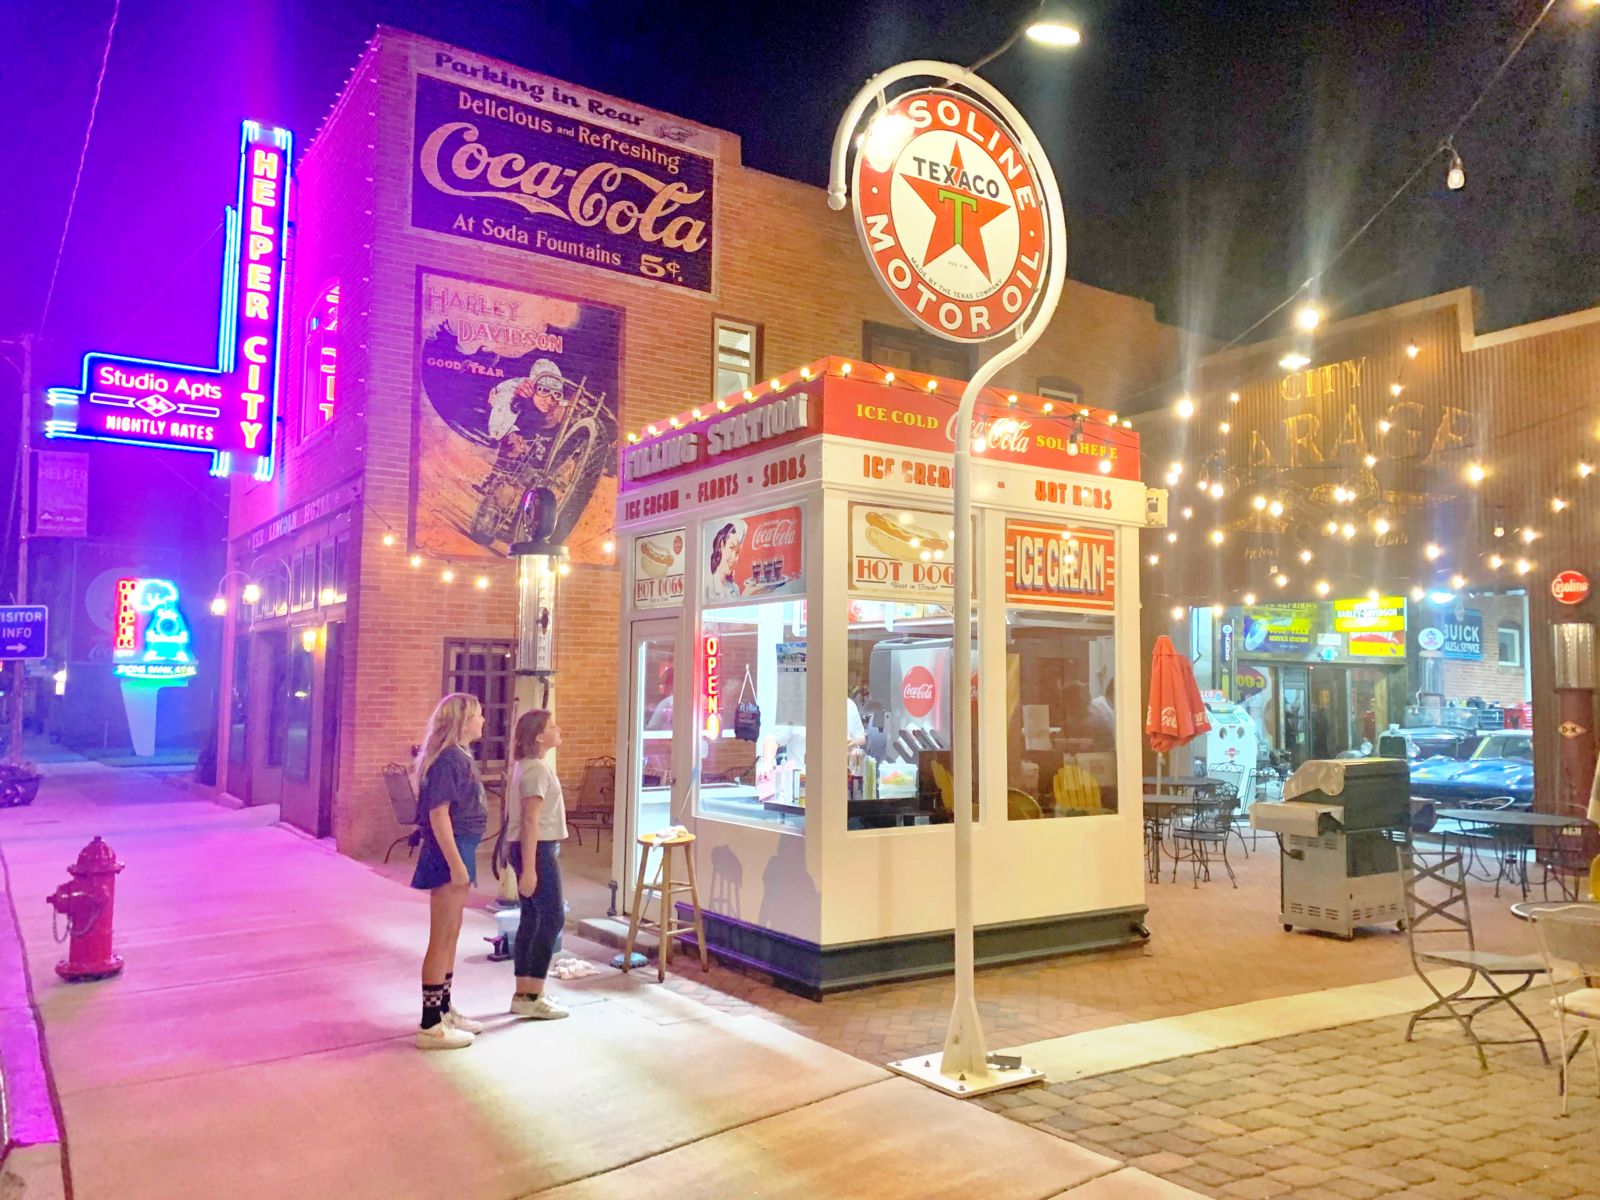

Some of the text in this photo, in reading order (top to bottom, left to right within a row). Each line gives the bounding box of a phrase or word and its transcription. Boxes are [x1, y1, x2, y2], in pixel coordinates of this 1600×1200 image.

[435, 52, 644, 127] Parking in Rear
[458, 91, 681, 174] Delicious and Refreshing
[908, 100, 1037, 212] SOLINE
[913, 156, 1000, 199] TEXACO
[420, 121, 707, 253] Coca-Cola
[453, 213, 475, 234] At
[482, 219, 529, 246] Soda
[536, 231, 621, 266] Fountains
[938, 188, 978, 246] T
[866, 214, 1040, 333] MOTOR OIL
[911, 257, 927, 278] MADE
[939, 284, 951, 296] THE
[953, 291, 974, 299] TEXAS
[975, 278, 1003, 298] COMPANY
[240, 150, 278, 449] HELPER CITY
[425, 286, 520, 321] HARLEY
[457, 318, 563, 354] DAVIDSON
[99, 366, 222, 400] Studio Apts
[1281, 356, 1366, 400] CITY
[106, 415, 214, 441] NIGHTLY RATES
[626, 392, 808, 481] FILLING STATION
[856, 404, 888, 421] ICE
[892, 411, 939, 430] COLD
[1036, 435, 1073, 452] SOL
[1248, 402, 1478, 468] ARAGE
[625, 454, 807, 521] ICE CREAM FLOATS SODAS
[902, 460, 955, 489] CREA
[1035, 479, 1112, 510] HOT DOGS
[857, 559, 955, 585] HOT DOG
[1015, 535, 1105, 593] ICE CREAM
[637, 576, 684, 599] HOT DOGS
[0, 612, 43, 623] ISITOR
[2, 627, 32, 639] INFO
[1444, 624, 1480, 642] BUICK
[706, 637, 719, 714] OPEN
